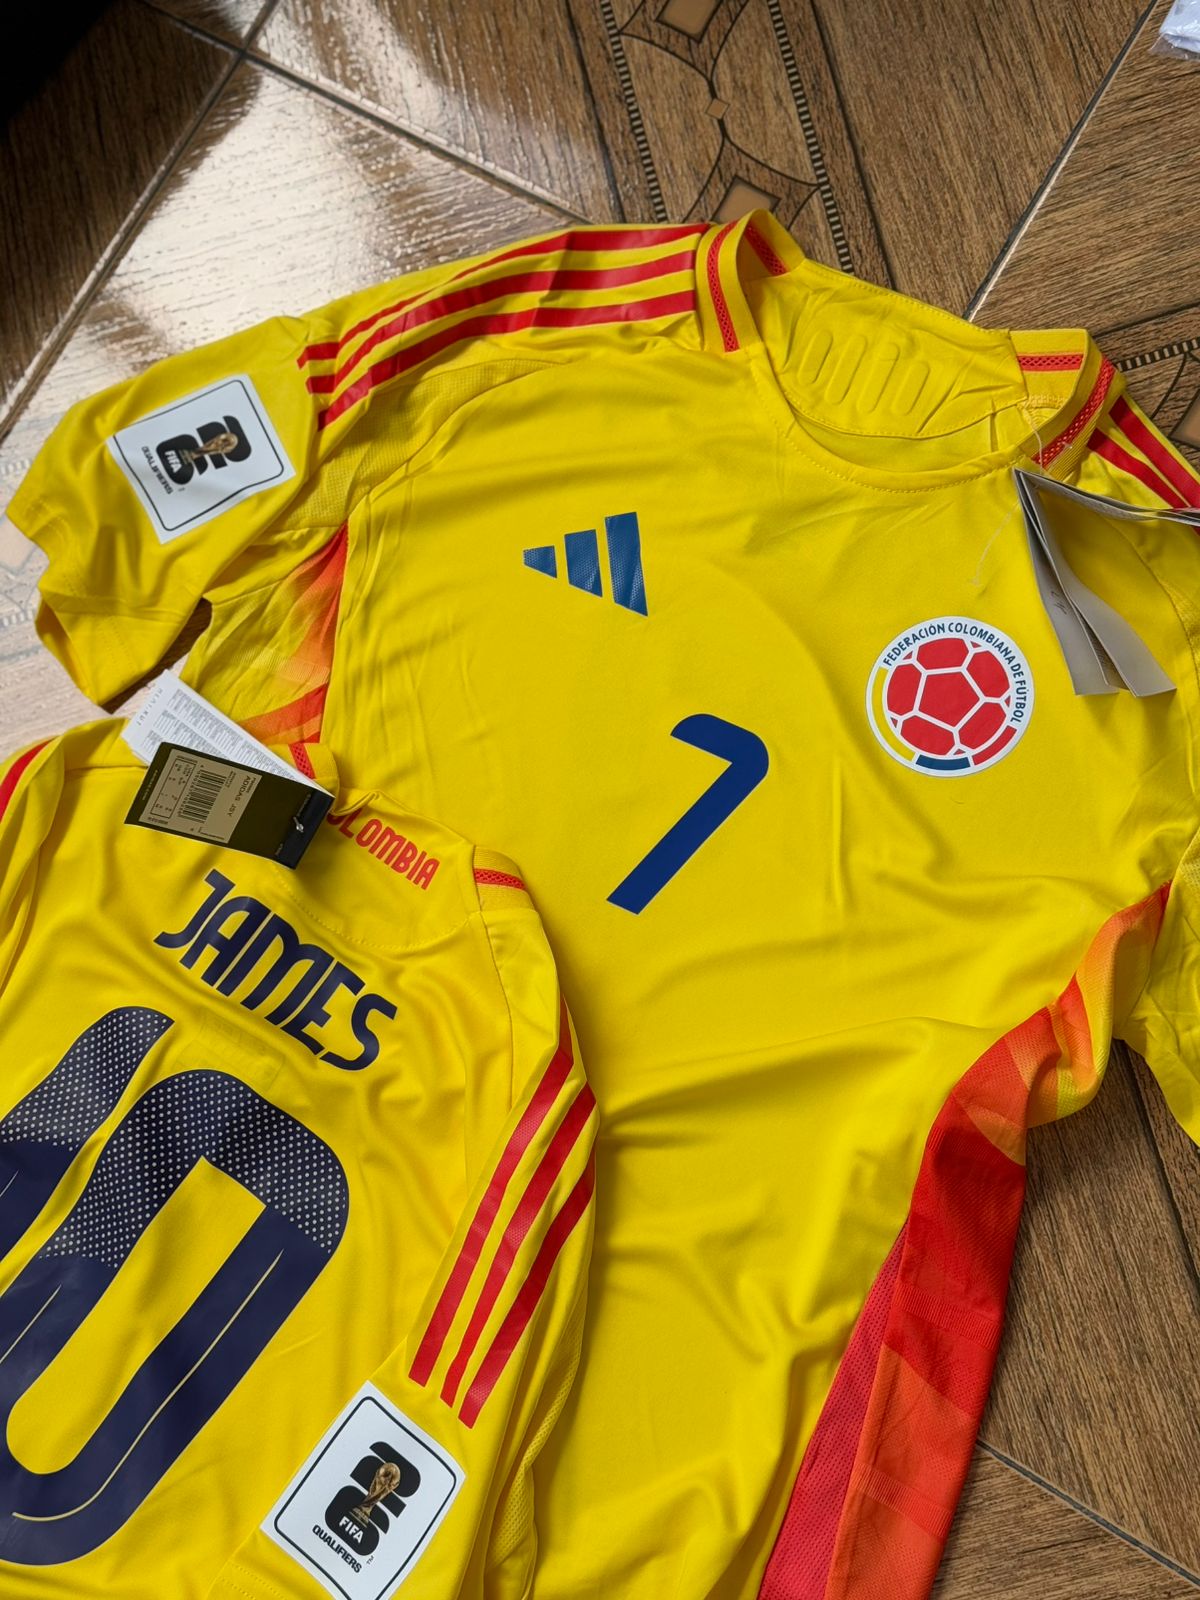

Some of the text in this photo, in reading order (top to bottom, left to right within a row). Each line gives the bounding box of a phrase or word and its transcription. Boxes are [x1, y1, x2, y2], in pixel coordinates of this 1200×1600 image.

[164, 450, 182, 474] FIFA
[883, 622, 1030, 723] FEDERACIÓN COLOMBIANA DE FÚTBOL
[235, 775, 251, 801] ADIDAS
[608, 714, 769, 914] 7
[153, 869, 396, 1072] JAMES
[311, 1524, 363, 1574] QUALIFIERS
[338, 1516, 365, 1545] FIFA
